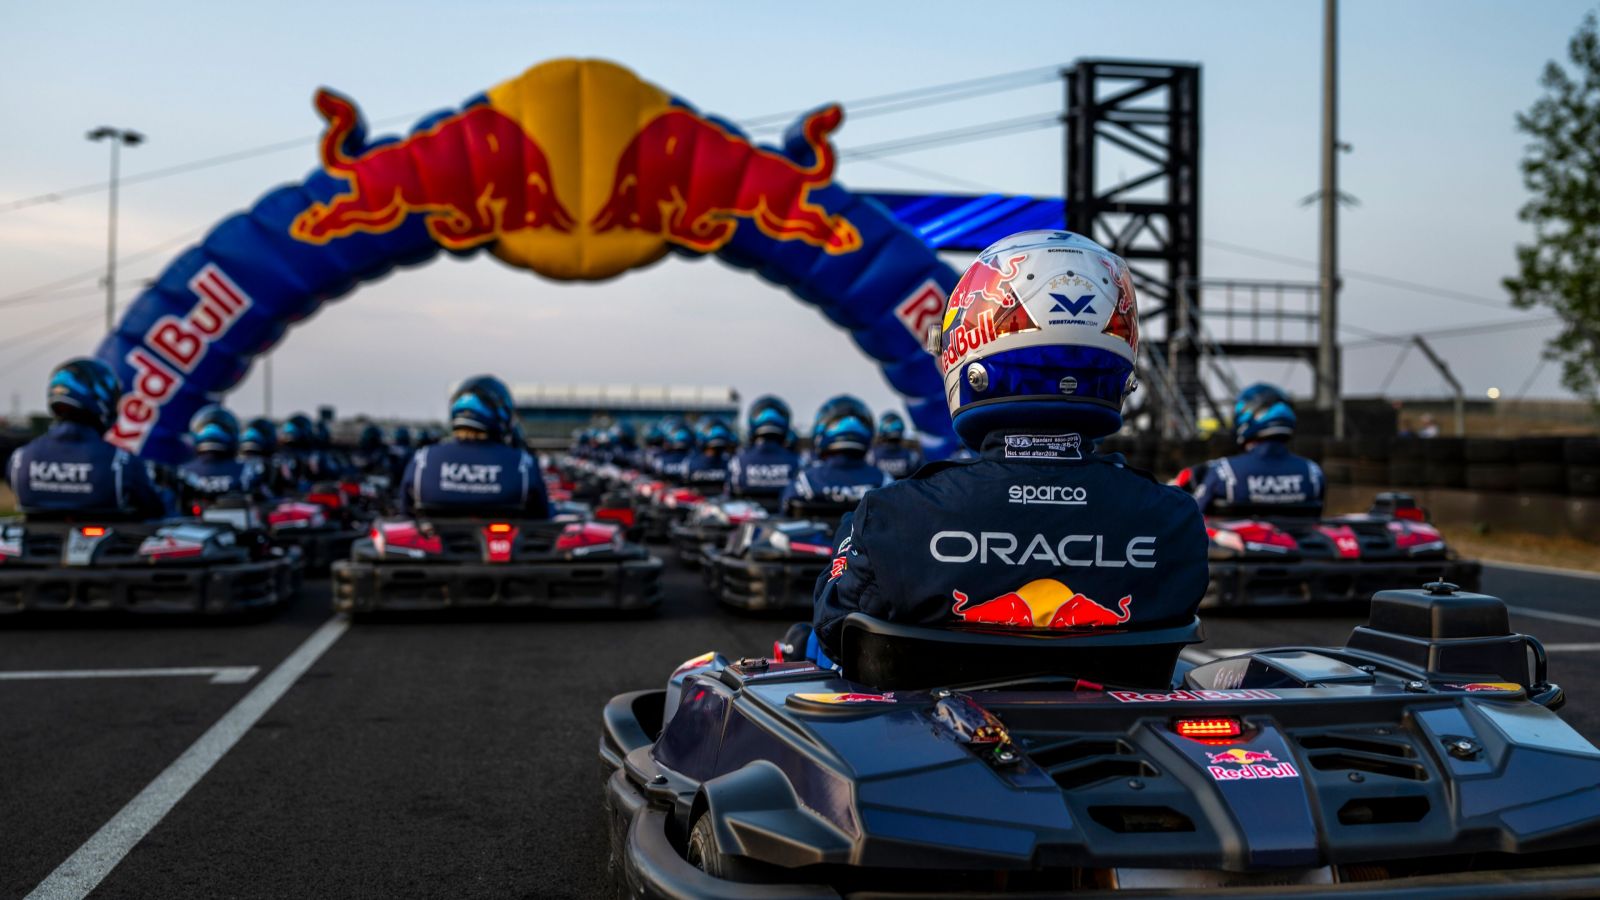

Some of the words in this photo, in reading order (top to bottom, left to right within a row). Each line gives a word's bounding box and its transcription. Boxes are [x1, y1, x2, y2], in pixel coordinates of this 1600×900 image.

[148, 265, 250, 370] Bull
[955, 308, 997, 357] Bull
[30, 461, 93, 483] KART
[441, 461, 502, 483] KART
[1008, 485, 1088, 505] sparco
[1247, 474, 1303, 494] KART
[929, 530, 1157, 569] ORACLE
[1110, 690, 1196, 703] Red
[1194, 689, 1279, 701] Bull
[1208, 765, 1254, 780] Red
[1252, 762, 1299, 779] Bull
